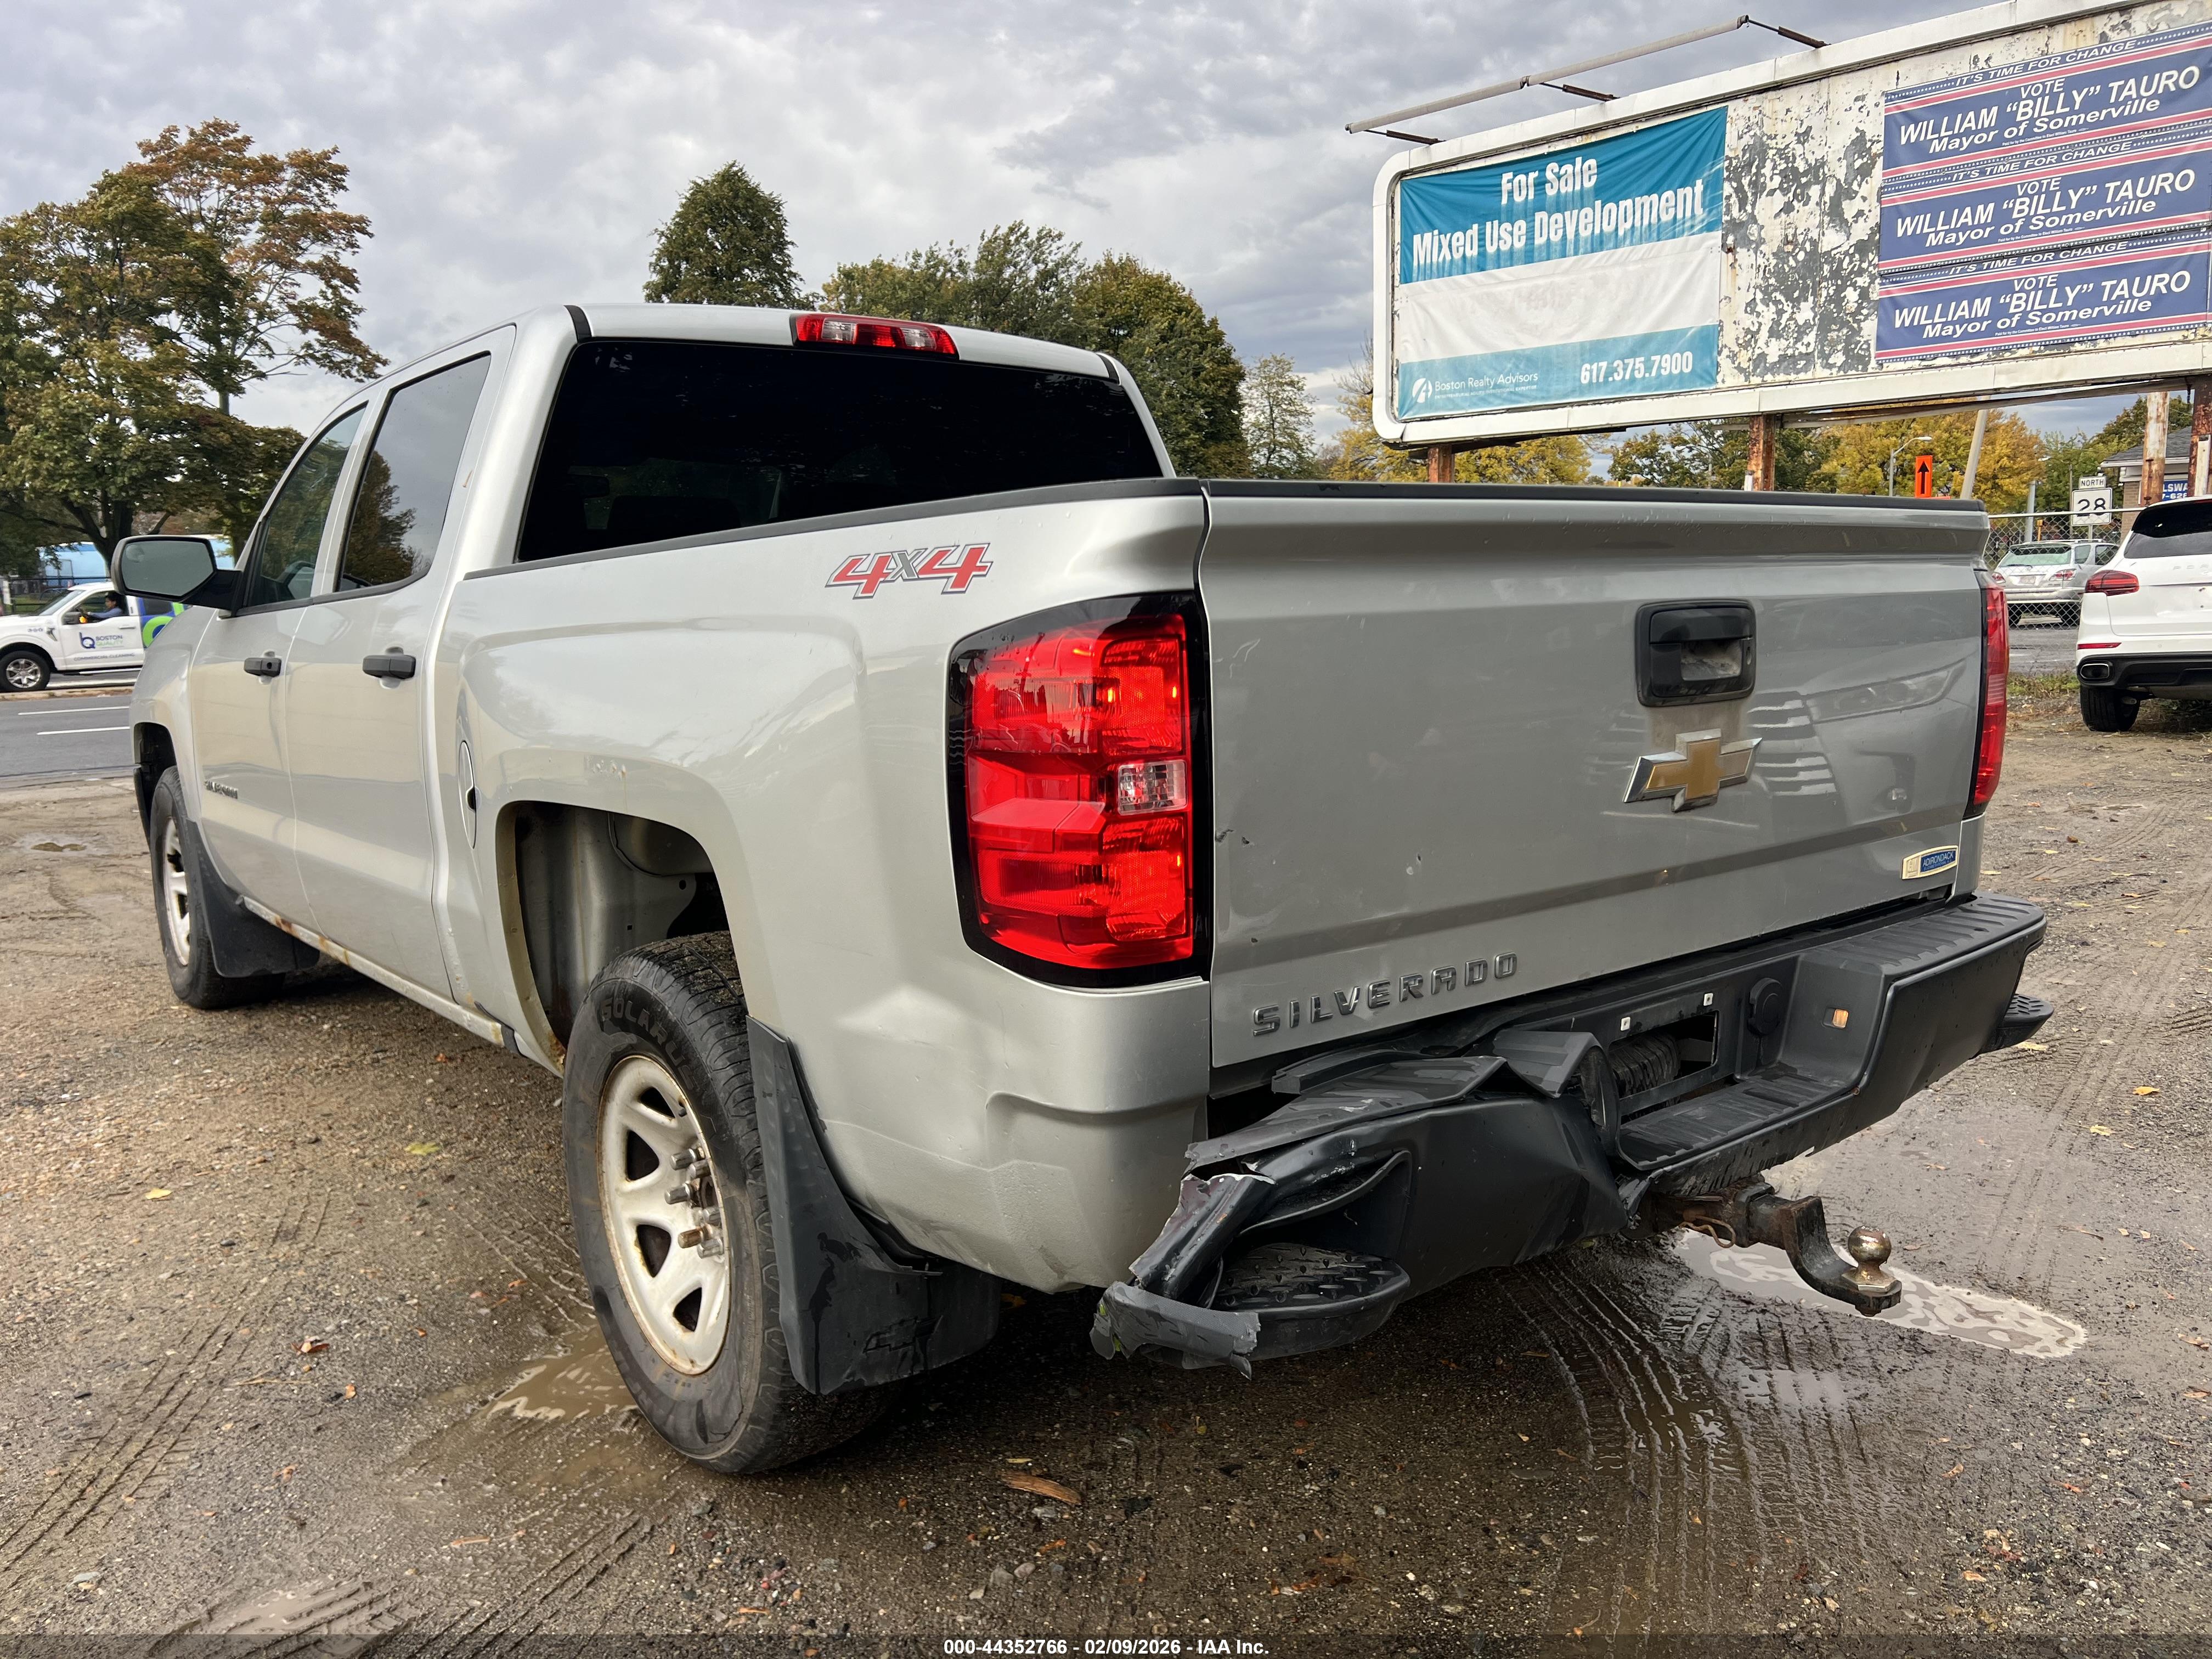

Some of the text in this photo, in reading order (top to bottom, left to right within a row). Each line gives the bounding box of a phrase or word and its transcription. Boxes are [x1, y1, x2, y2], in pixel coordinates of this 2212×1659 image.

[1989, 65, 2023, 80] TIME
[2028, 57, 2059, 70] FOR
[2065, 40, 2137, 63] CHANGE
[1900, 106, 1997, 144] WILLIAM
[2108, 66, 2200, 99] TAURO
[2021, 78, 2066, 99] VOTE
[1929, 98, 2160, 154] Mayor of Somerville
[1985, 161, 2021, 177] TIME
[2024, 154, 2056, 168] FOR
[2062, 141, 2131, 162] CHANGE
[1500, 157, 1598, 205] For Sale
[2017, 177, 2061, 197] VOTE
[1412, 178, 1703, 267] Mixed Use Development
[1897, 203, 1994, 238] WILLIAM
[2105, 169, 2195, 198] TAURO
[1926, 199, 2156, 247] Mayor of Somerville
[1982, 256, 2018, 270] TIME
[2021, 250, 2054, 263] FOR
[2059, 240, 2128, 259] CHANGE
[1894, 297, 1991, 328] WILLIAM
[2101, 270, 2191, 301] TAURO
[2014, 274, 2058, 292] VOTE
[1923, 297, 2152, 339] Mayor of Somerville
[1435, 373, 1538, 391] Boston Realty Advisors
[1580, 351, 1693, 385] 617.375.7900
[2078, 498, 2106, 517] 28
[1923, 851, 1953, 867] ADIRONDACK
[1252, 952, 1517, 1036] SILVERADO
